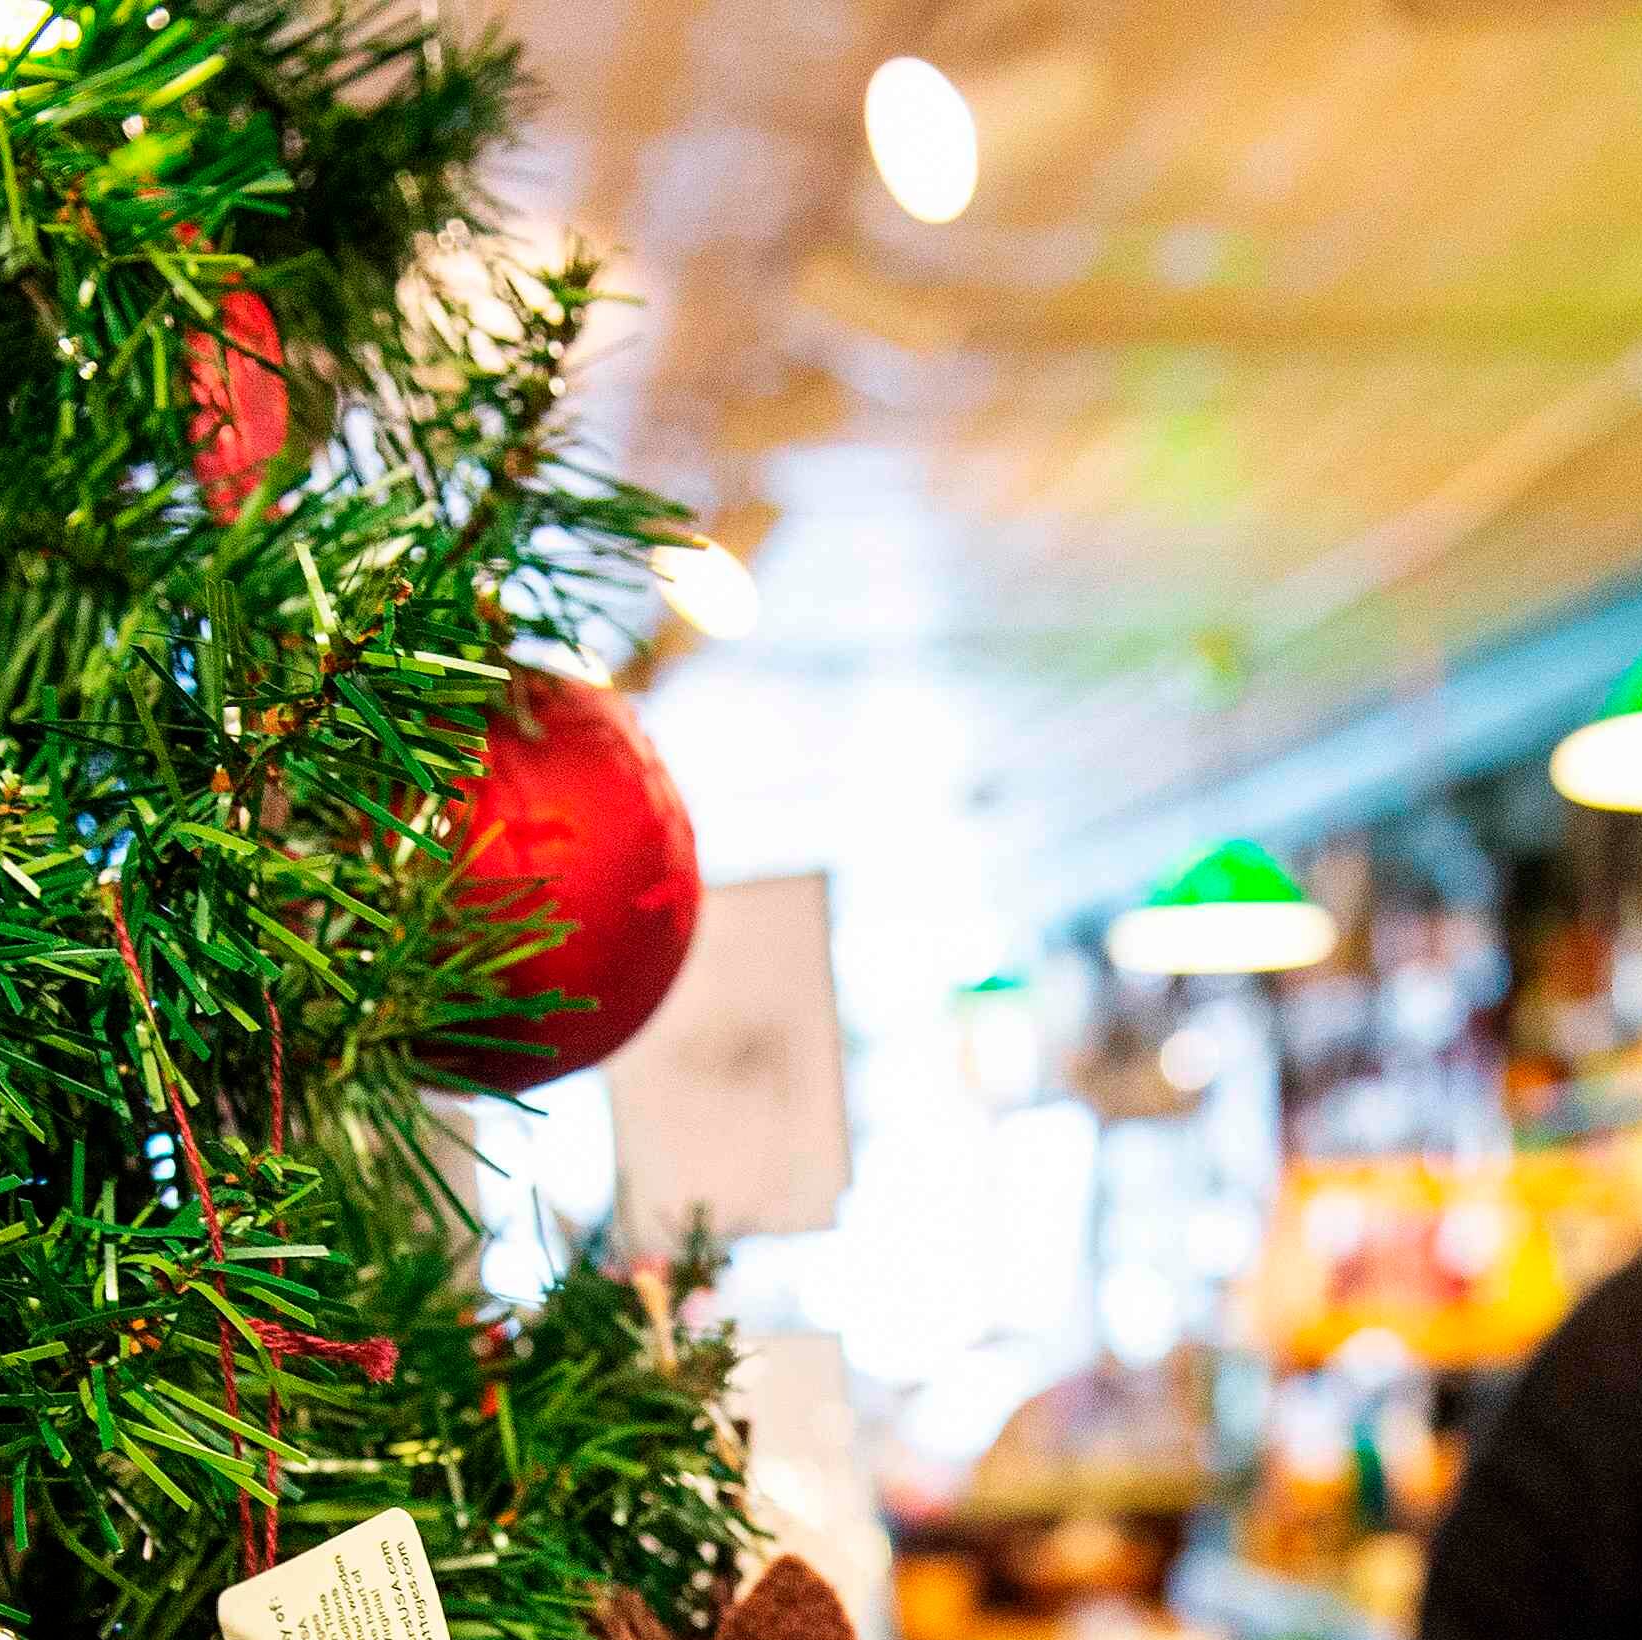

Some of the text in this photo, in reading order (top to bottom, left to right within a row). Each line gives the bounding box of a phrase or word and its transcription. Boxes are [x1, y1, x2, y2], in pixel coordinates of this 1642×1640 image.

[333, 1553, 357, 1612] wooden
[349, 1568, 362, 1584] of
[267, 1595, 285, 1623] of:
[318, 1592, 334, 1630] Time
[356, 1586, 374, 1625] heart
